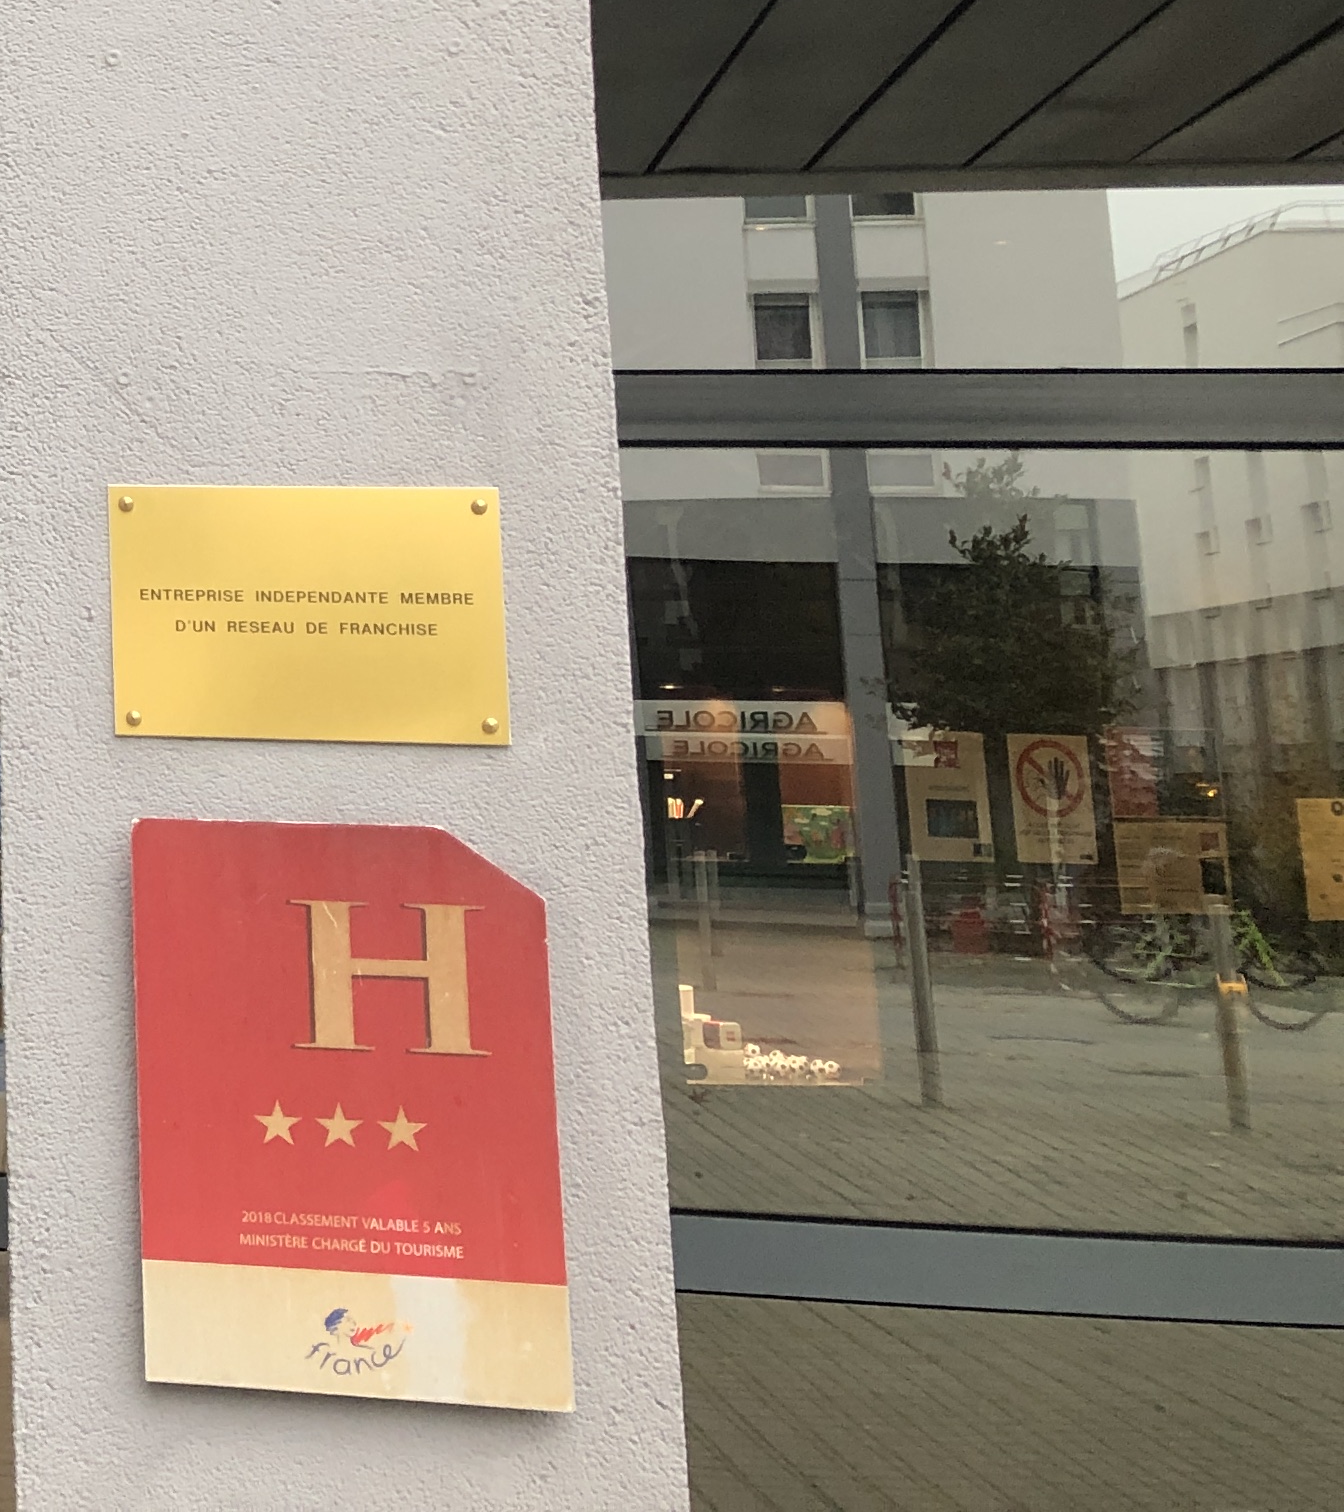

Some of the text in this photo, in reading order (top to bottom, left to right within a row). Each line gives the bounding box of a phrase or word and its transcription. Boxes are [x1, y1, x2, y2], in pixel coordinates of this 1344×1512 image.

[139, 588, 475, 606] ENTREPRISE INDEPENDANTE MEMBRE
[175, 620, 438, 637] D'UN RESEAU DE FRANCHISE
[286, 899, 492, 1057] H
[242, 1211, 462, 1236] 2018 CLASSEMENT VALABLE 5 ANS
[370, 1240, 391, 1255] DU
[394, 1242, 465, 1260] TOURISME
